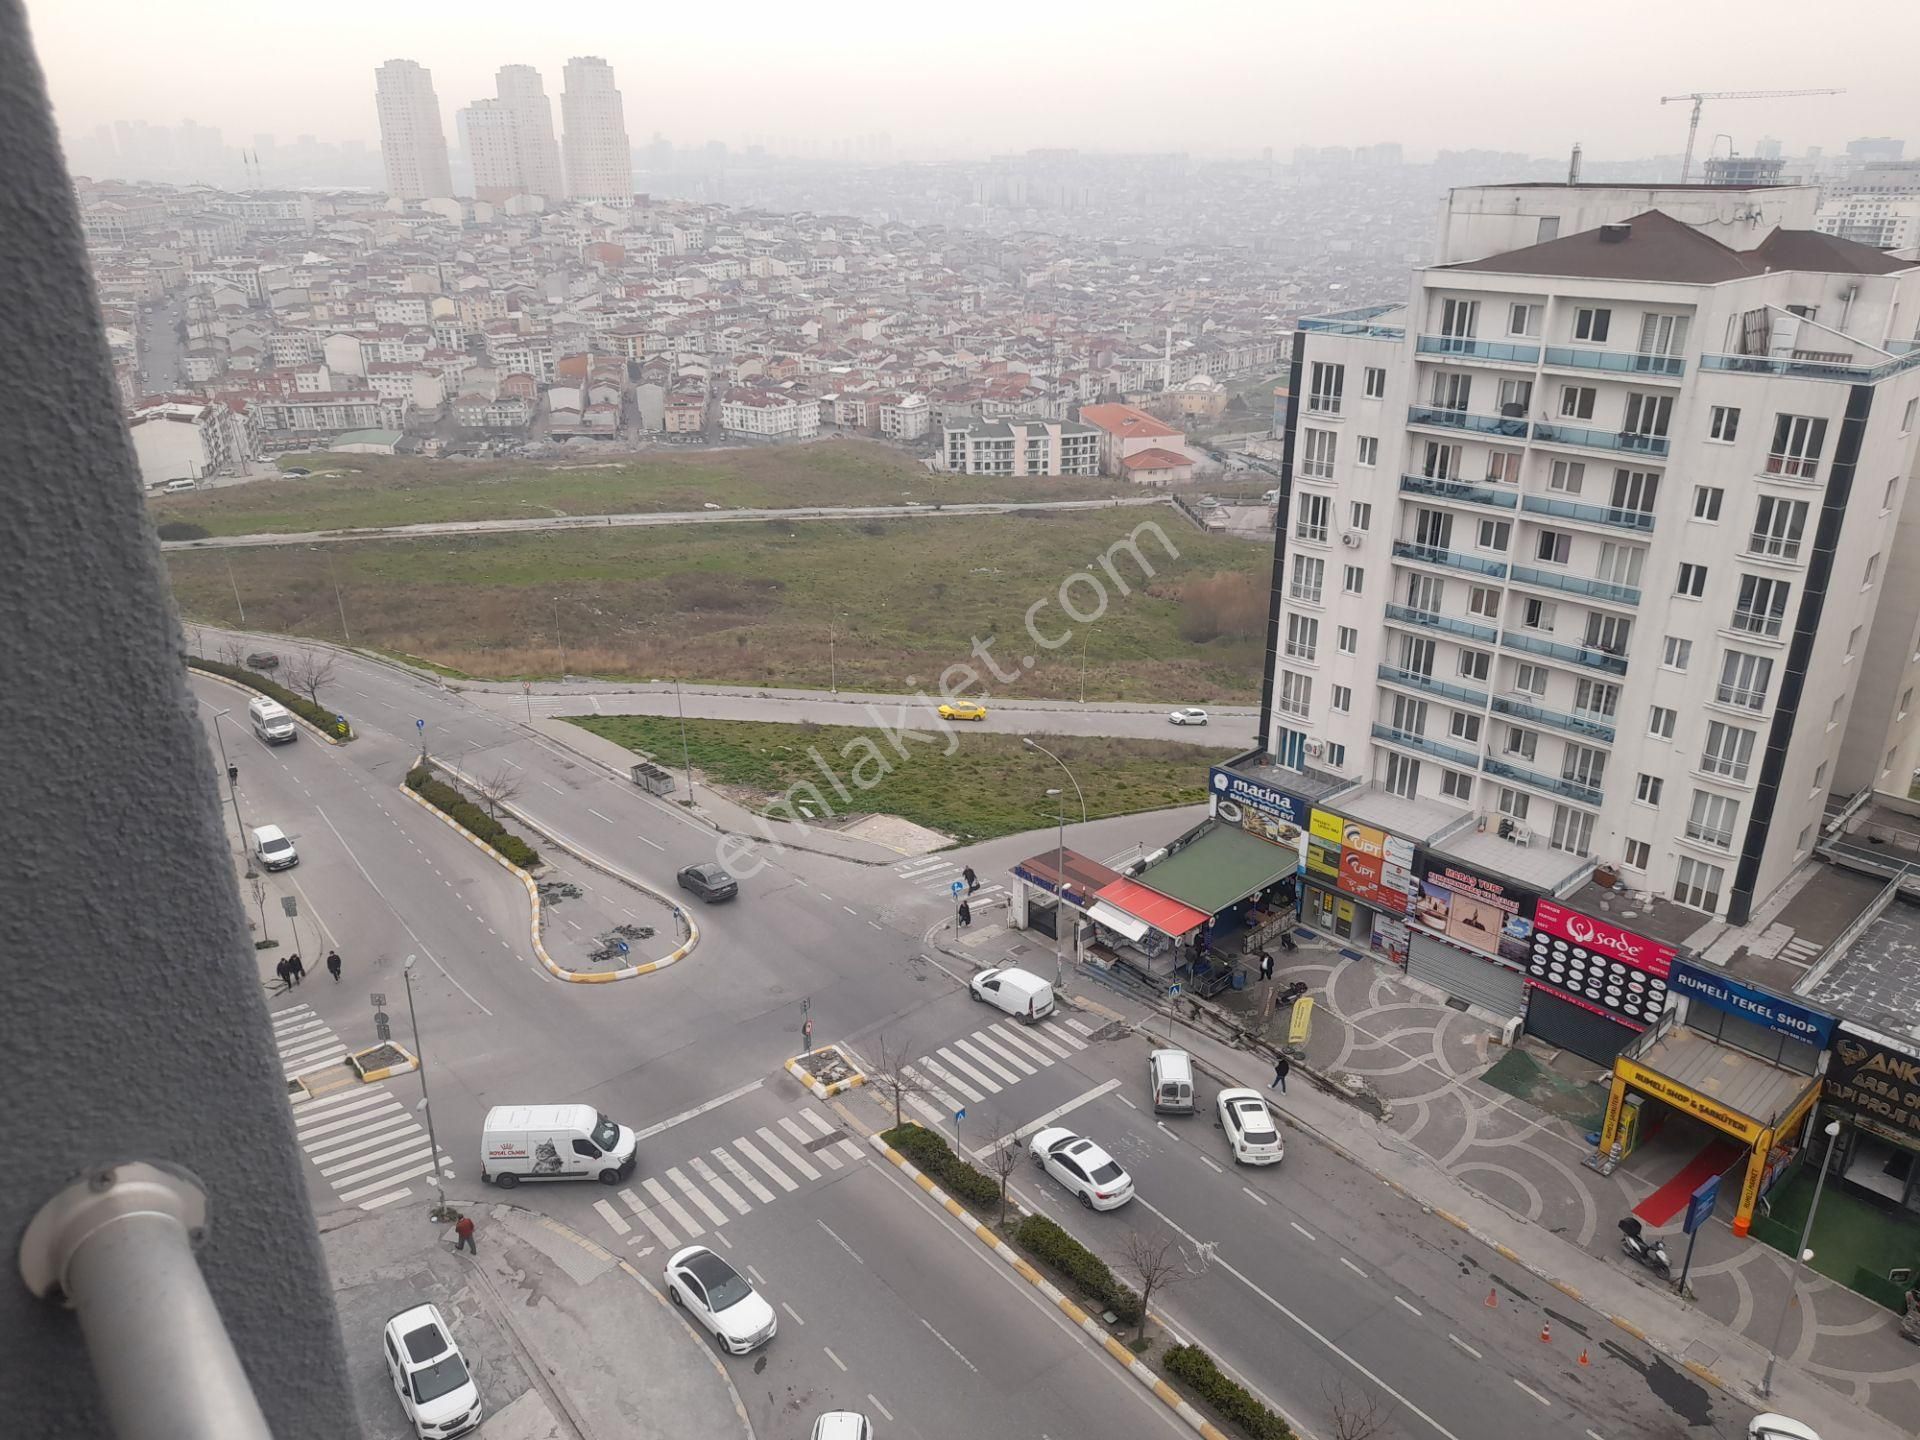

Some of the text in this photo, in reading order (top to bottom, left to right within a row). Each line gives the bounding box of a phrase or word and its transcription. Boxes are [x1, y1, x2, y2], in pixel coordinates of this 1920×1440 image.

[1233, 780, 1293, 809] marina
[1259, 803, 1280, 817] MEZE
[1353, 837, 1382, 858] UPT
[1352, 860, 1376, 879] UPT
[1678, 974, 1817, 1034] RUMELİ TEKEL SHOP
[1635, 1072, 1666, 1092] RUMELİ
[1666, 1088, 1690, 1104] SHOP
